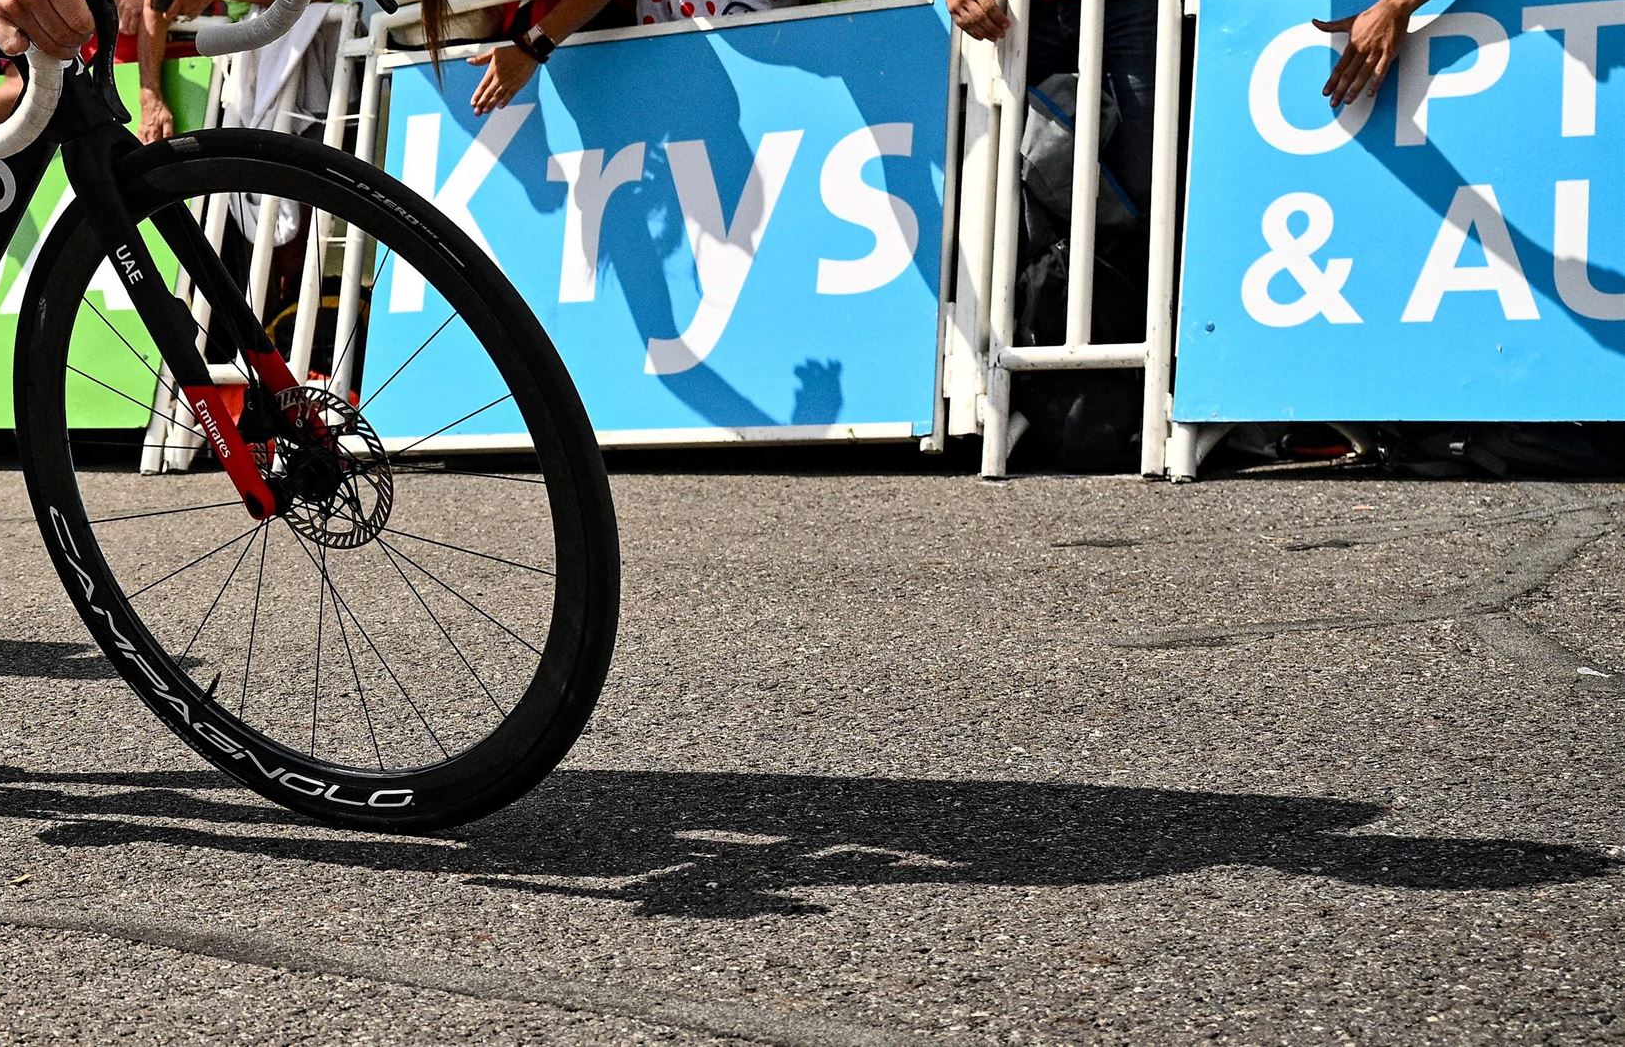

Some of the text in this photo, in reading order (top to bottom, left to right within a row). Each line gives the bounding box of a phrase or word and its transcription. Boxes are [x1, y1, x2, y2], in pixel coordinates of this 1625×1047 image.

[1248, 0, 1625, 155] OPT
[115, 244, 144, 285] UAE
[371, 190, 420, 226] ZERO
[388, 103, 920, 375] Krys
[1241, 179, 1625, 328] & AU
[195, 399, 231, 459] Emirates
[49, 504, 415, 808] CAMPAGNOLO
